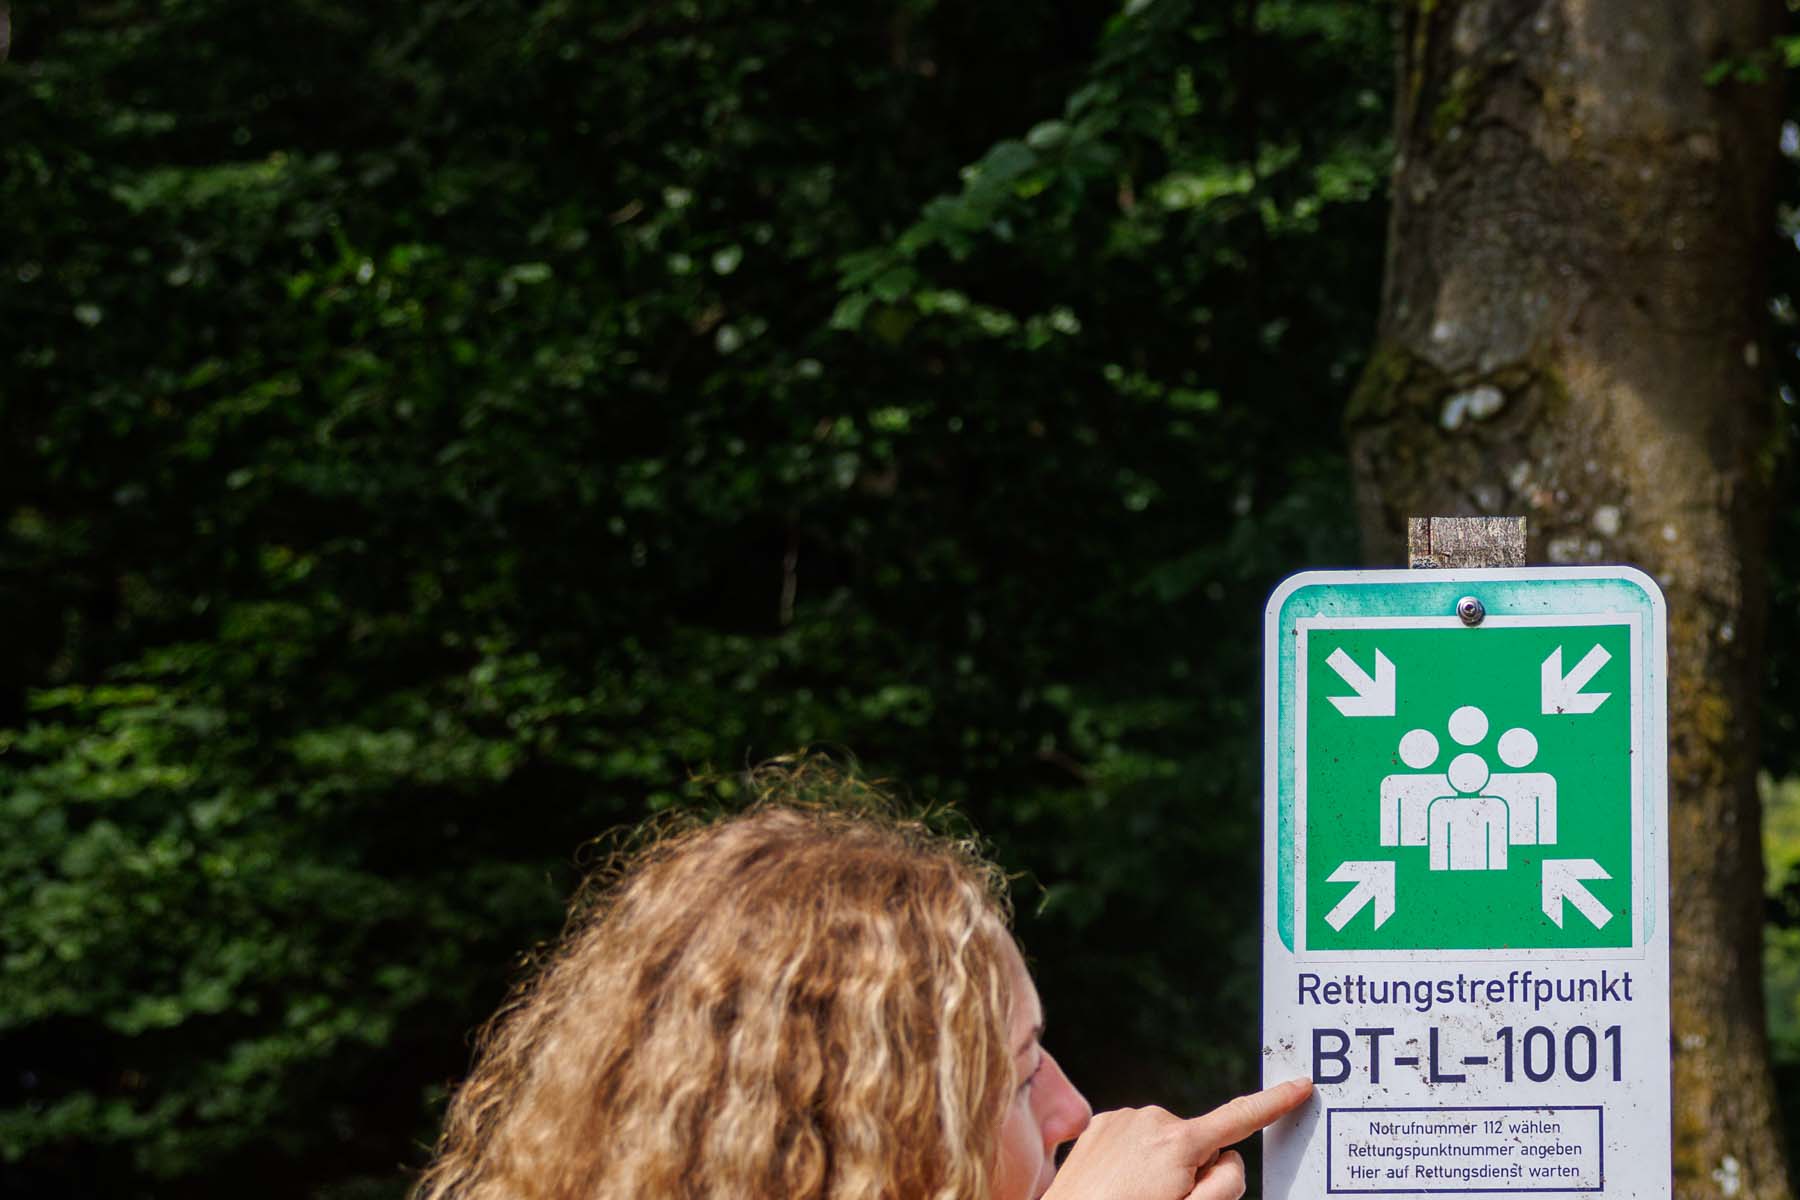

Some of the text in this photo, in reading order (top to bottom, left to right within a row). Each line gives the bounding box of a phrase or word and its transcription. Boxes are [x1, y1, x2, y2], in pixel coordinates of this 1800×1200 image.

[1297, 970, 1633, 1012] Rettungstreffpunkt
[1312, 1024, 1623, 1085] BT-L-1001
[1368, 1119, 1561, 1135] Notrufnummer 112 wählen
[1347, 1142, 1582, 1158] Rettungspunktnummer angeben
[1351, 1164, 1580, 1180] Hier auf Rettungsdienst warten
